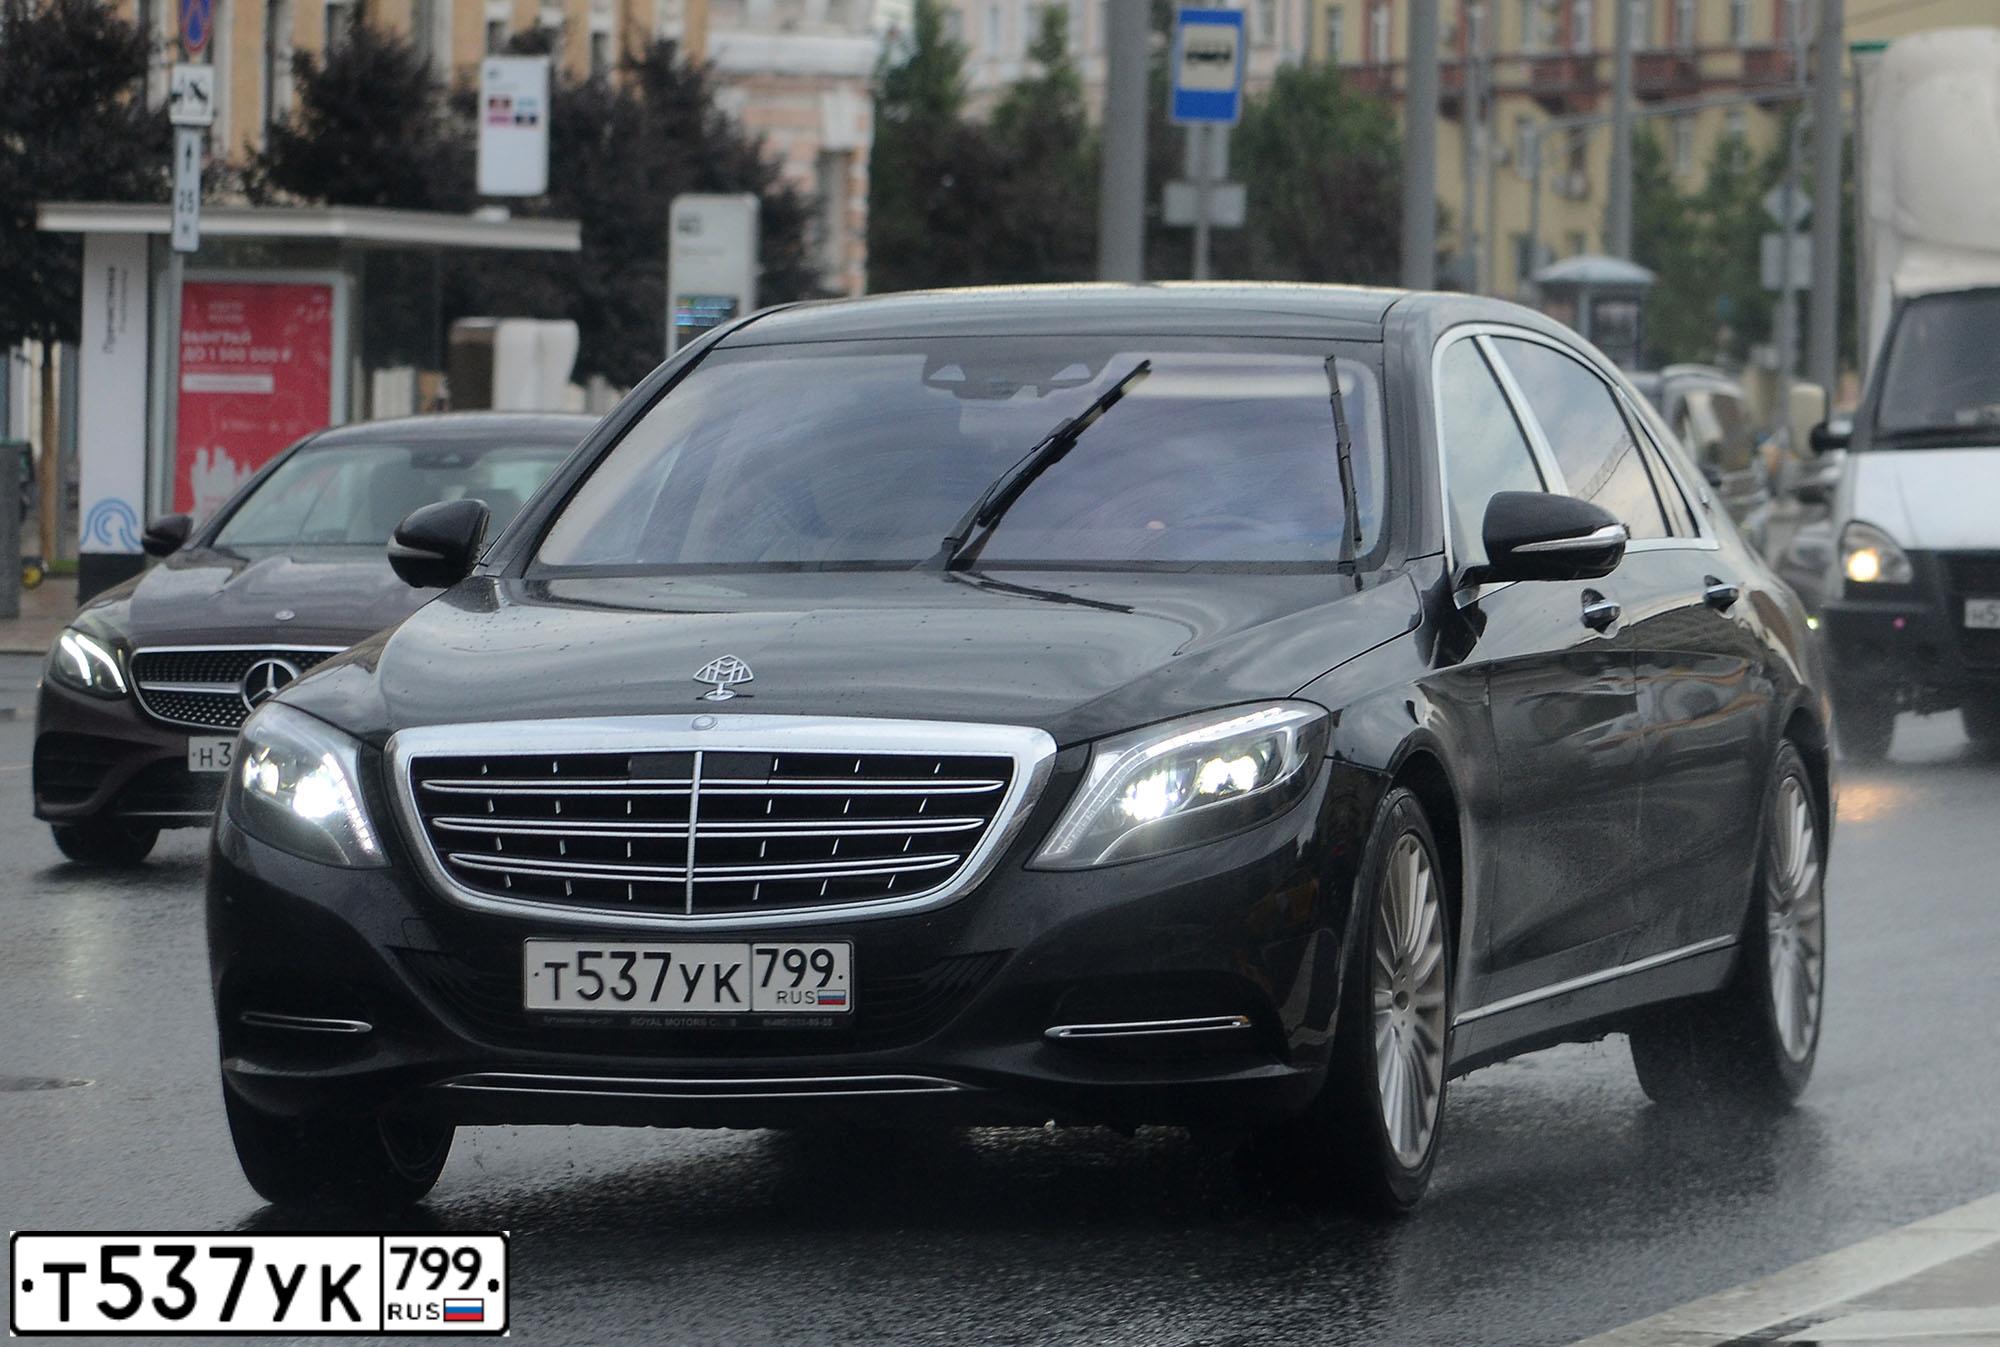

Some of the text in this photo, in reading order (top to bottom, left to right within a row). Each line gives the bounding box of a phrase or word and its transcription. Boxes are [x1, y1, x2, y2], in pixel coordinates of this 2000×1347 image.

[544, 948, 835, 1003] Т537УК 799
[776, 990, 816, 1004] RUS
